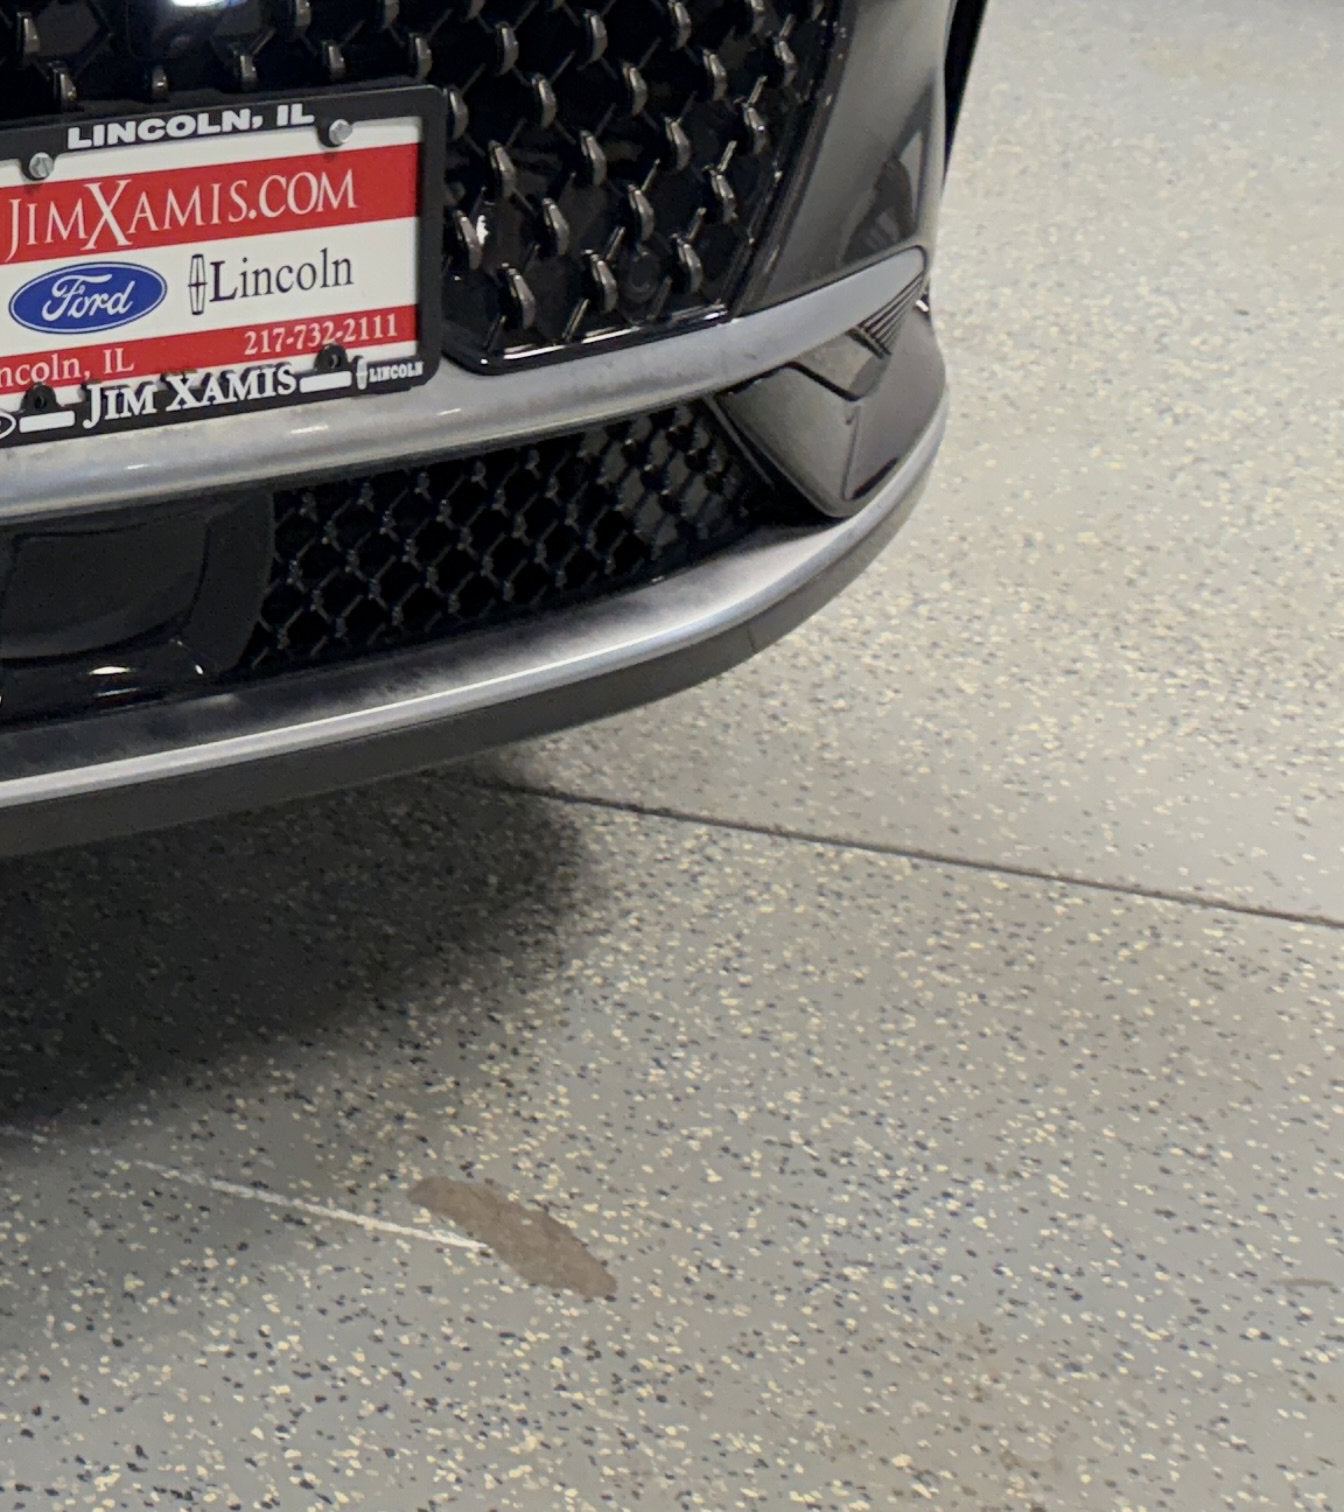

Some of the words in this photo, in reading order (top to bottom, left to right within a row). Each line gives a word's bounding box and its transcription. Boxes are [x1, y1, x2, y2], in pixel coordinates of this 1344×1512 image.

[67, 107, 263, 150] LINCOLN,
[276, 102, 316, 126] IL
[41, 273, 136, 322] Ford
[208, 247, 355, 303] Lincoln
[244, 313, 398, 356] 217-732-2111
[102, 347, 135, 375] IL
[368, 360, 425, 384] LINCOLN
[81, 382, 161, 429] JIM
[164, 362, 298, 412] XAMIS
